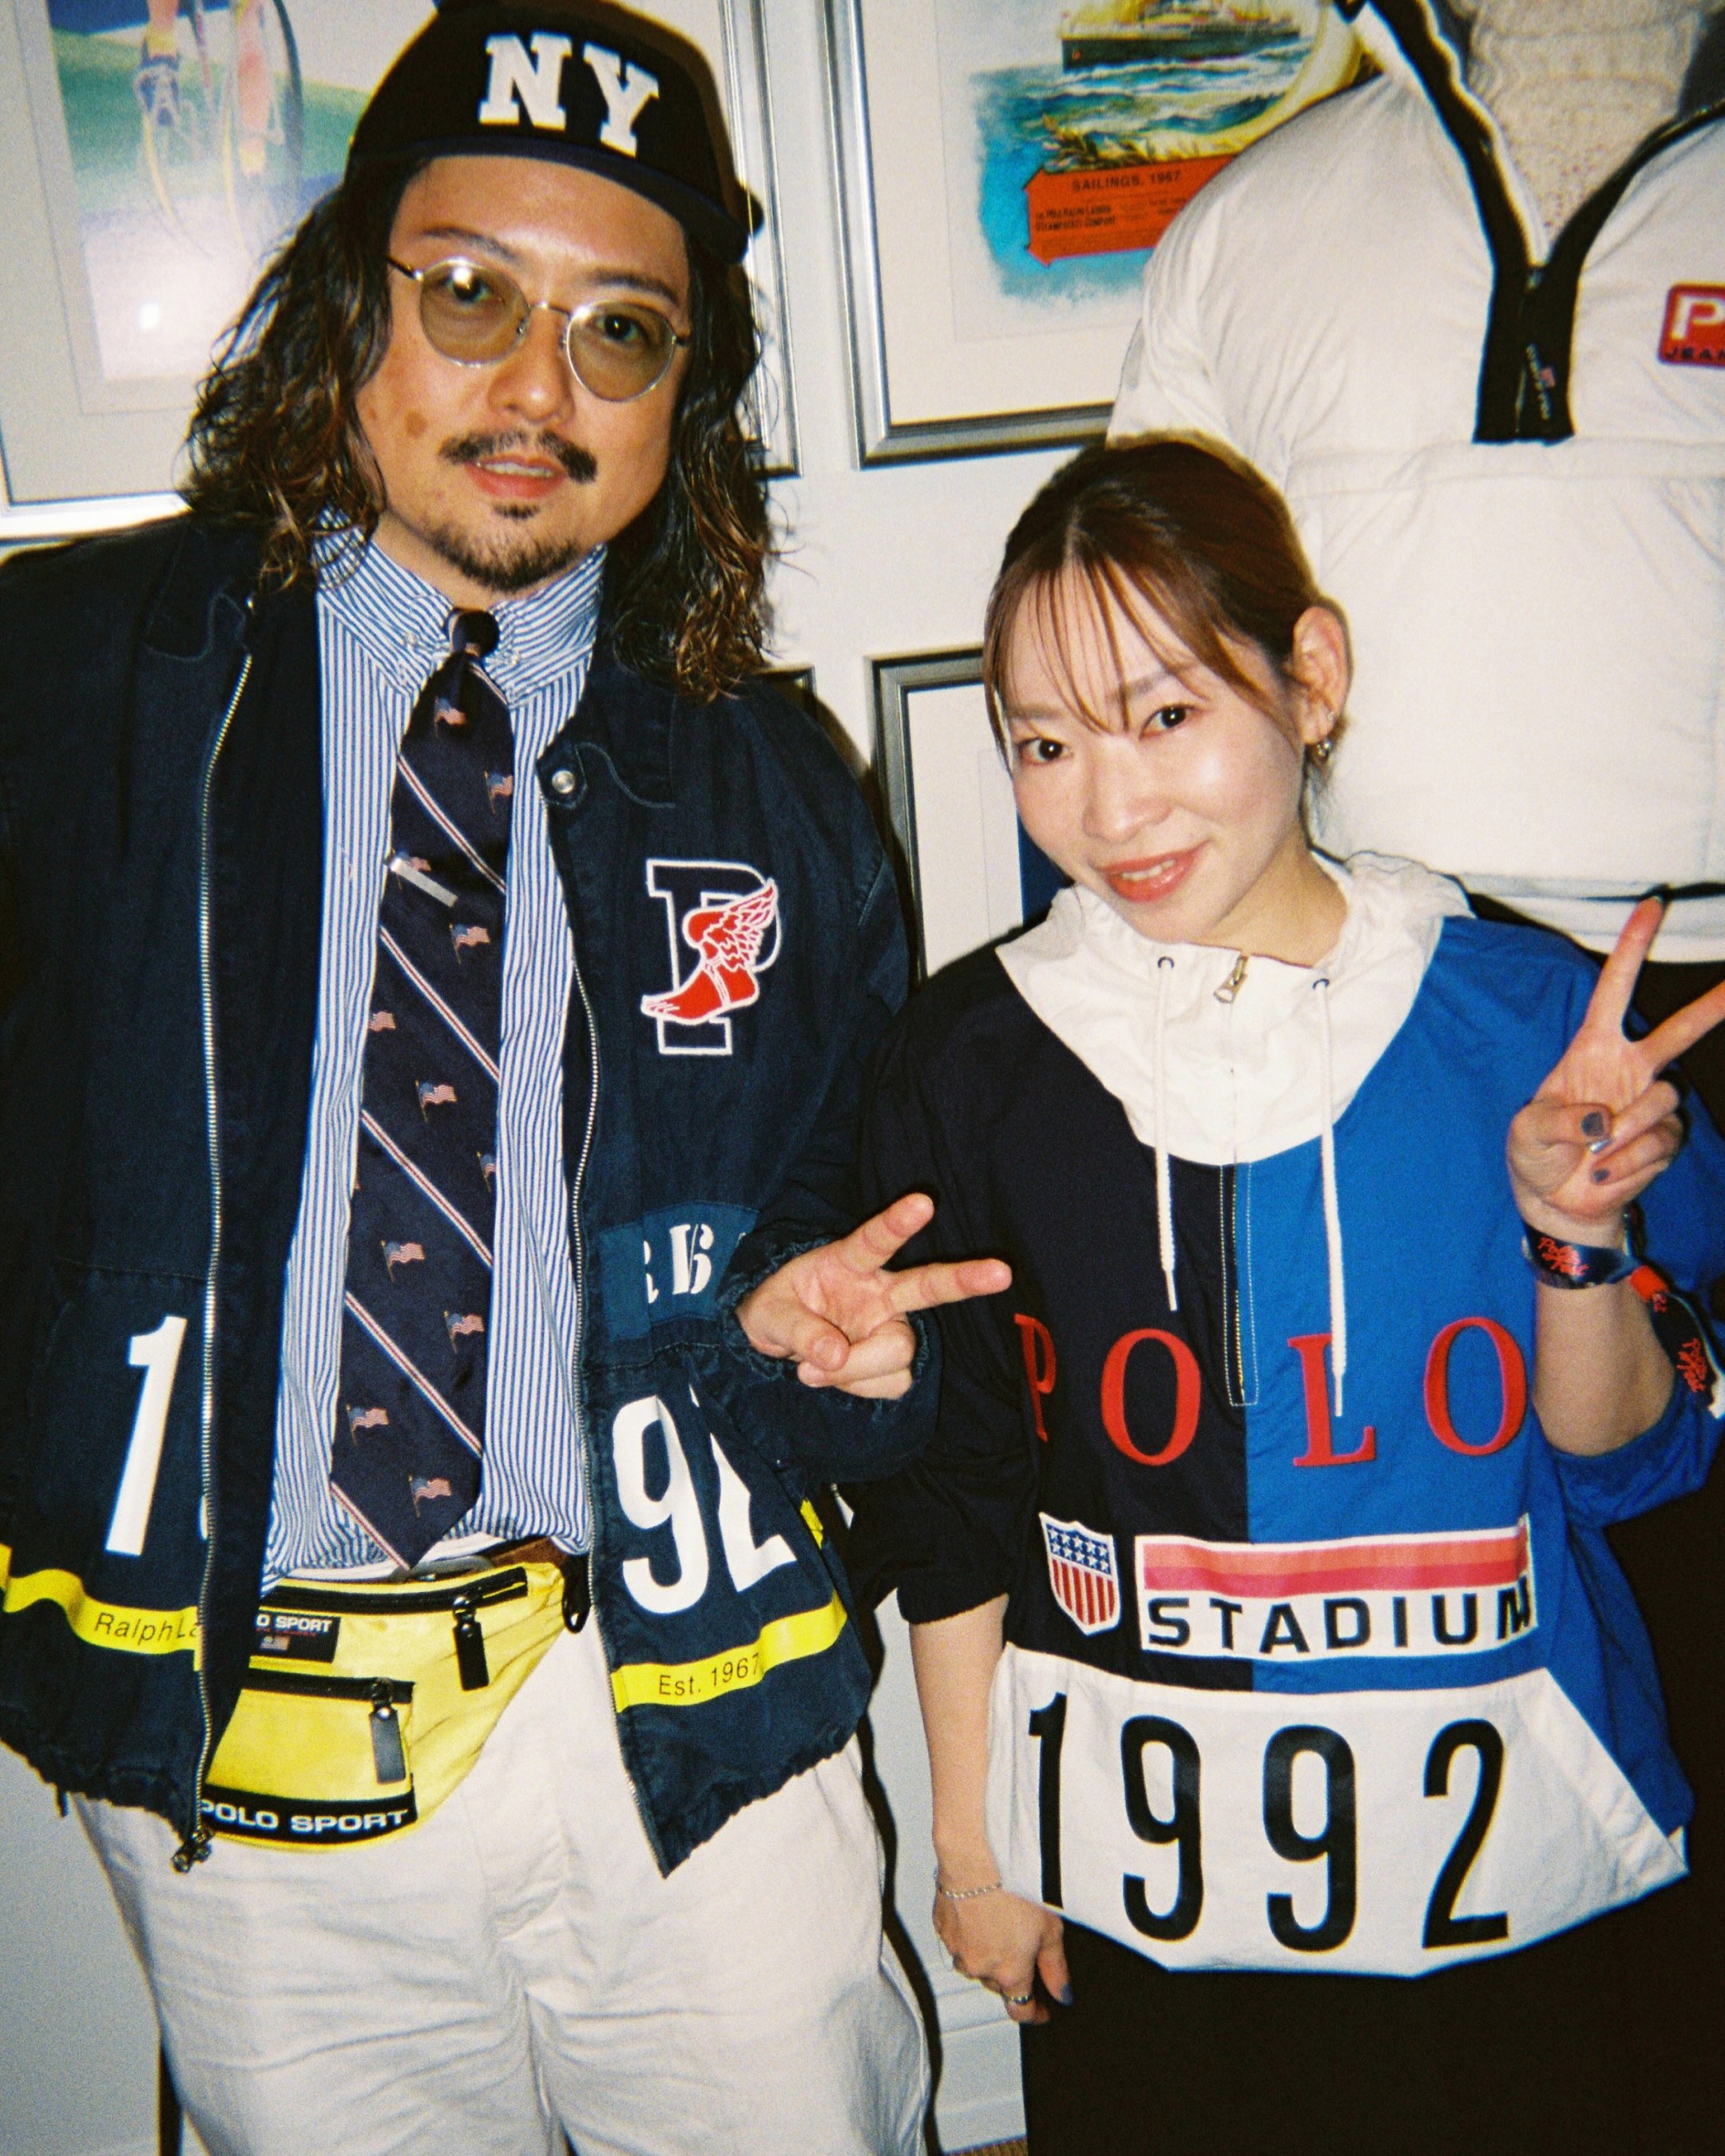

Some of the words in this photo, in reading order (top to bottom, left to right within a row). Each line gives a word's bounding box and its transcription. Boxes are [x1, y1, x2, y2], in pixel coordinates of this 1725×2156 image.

[478, 30, 659, 158] NY
[1151, 169, 1181, 184] 1967
[1014, 1313, 1529, 1467] POLO
[105, 1316, 208, 1556] 1
[275, 1615, 332, 1634] SPORT
[1148, 1574, 1531, 1654] STADIUM
[659, 1674, 701, 1696] Est.
[711, 1651, 759, 1687] 1967
[290, 1808, 409, 1834] SPORT
[1028, 1692, 1509, 1952] 1992
